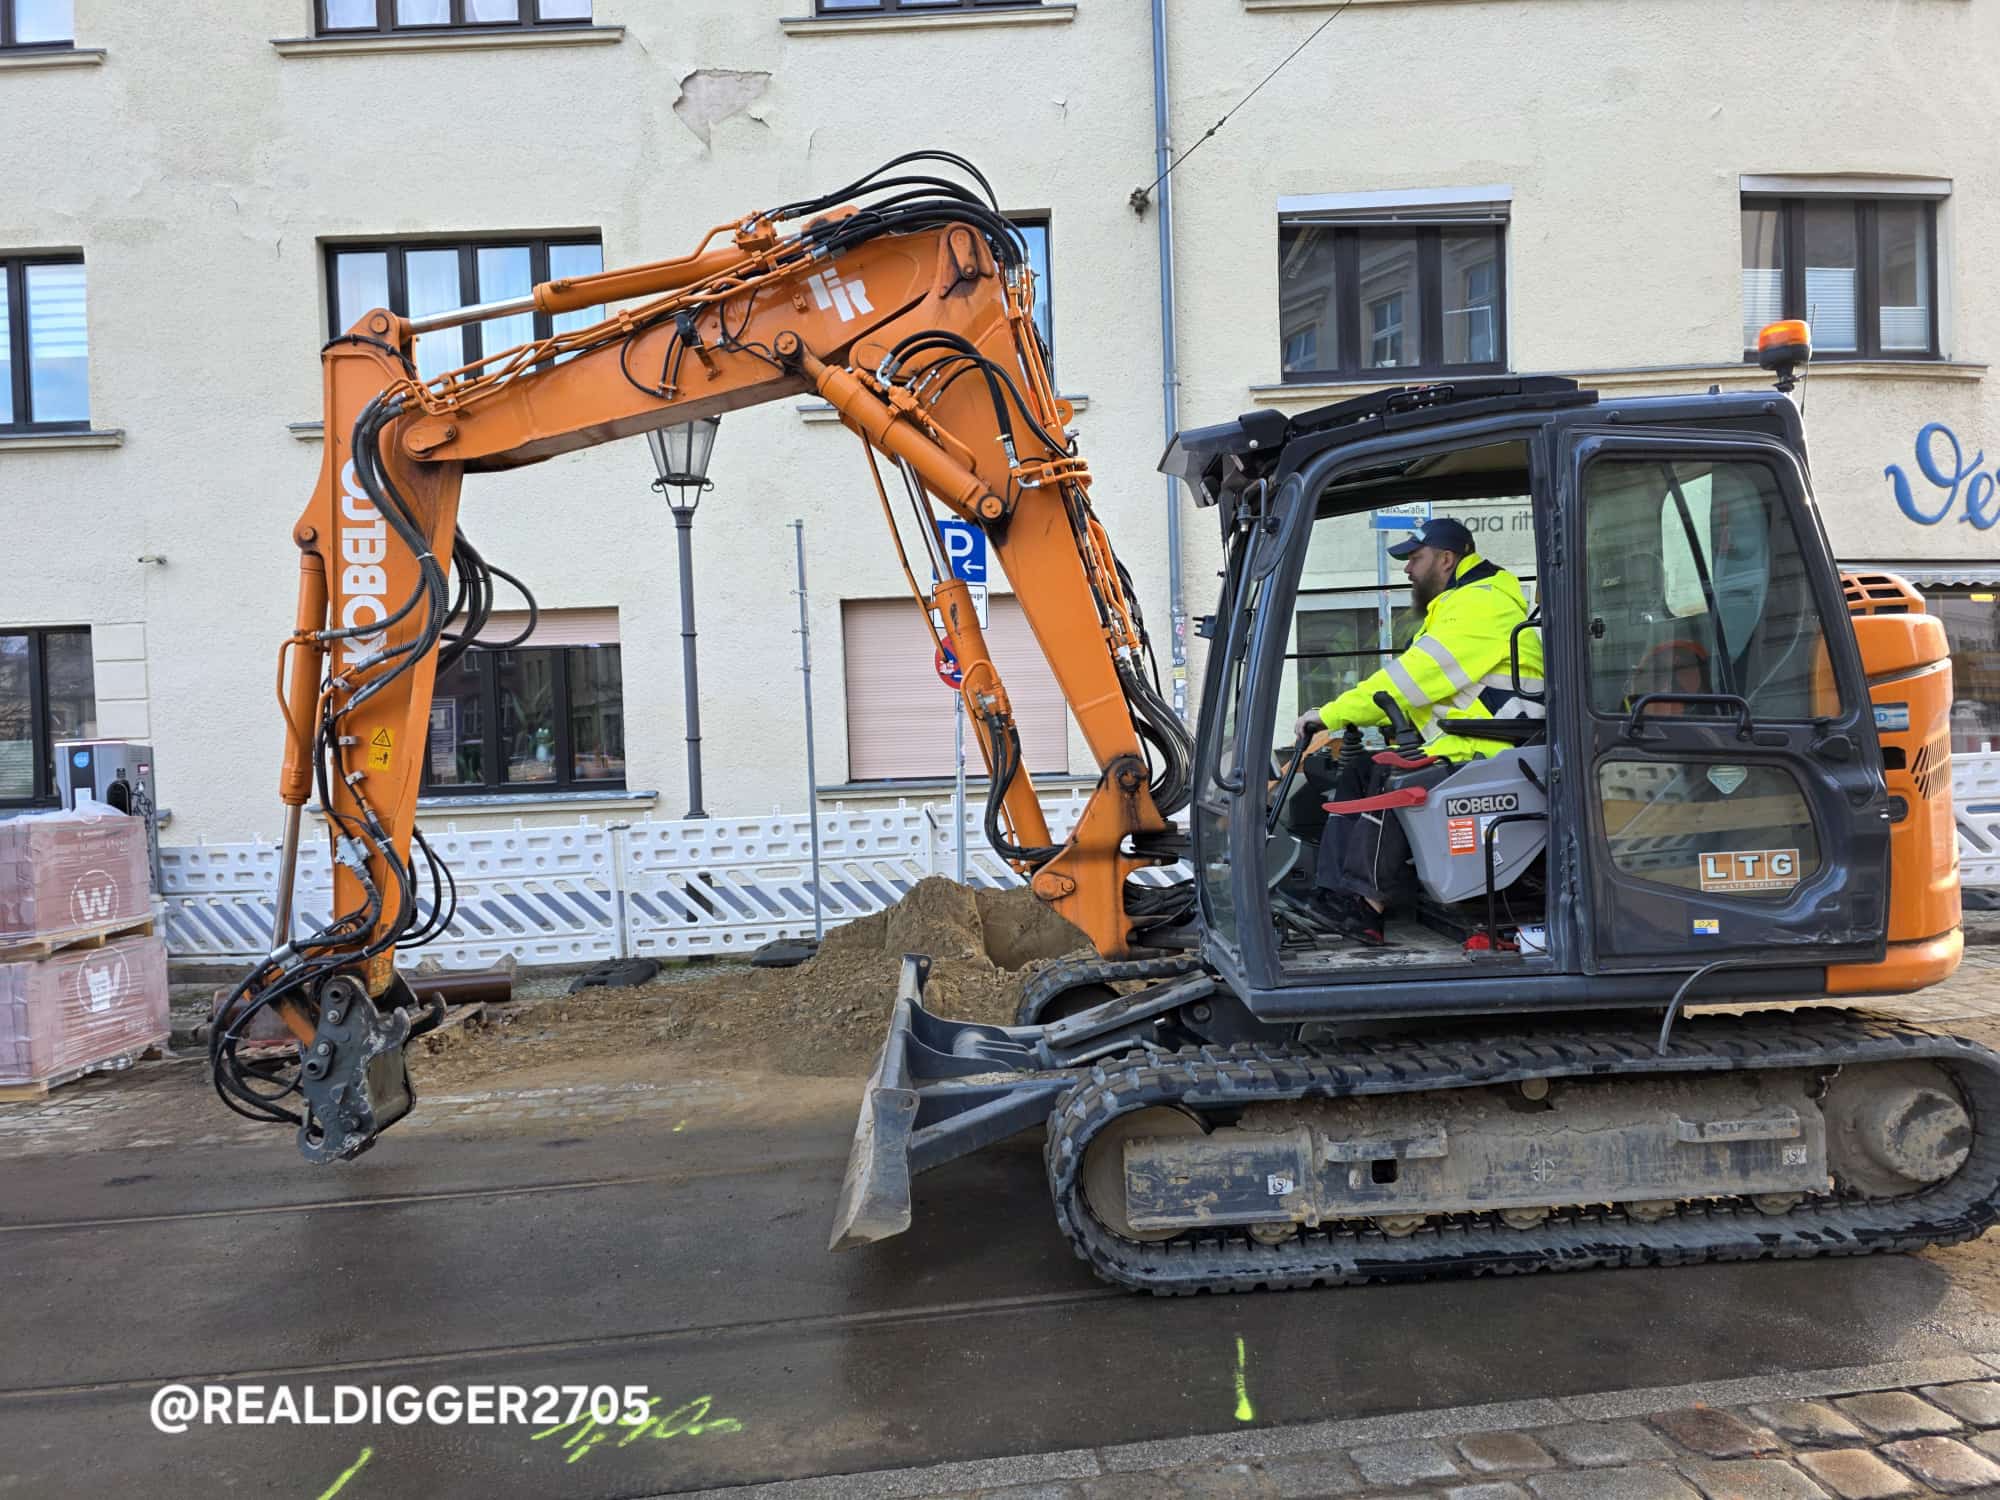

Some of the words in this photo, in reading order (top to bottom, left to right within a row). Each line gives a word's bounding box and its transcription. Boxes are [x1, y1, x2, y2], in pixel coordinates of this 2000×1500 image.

[1883, 422, 2000, 531] Ve
[1511, 511, 1535, 531] rit
[944, 528, 974, 564] P
[1447, 794, 1517, 816] KOBELCO
[1705, 853, 1793, 879] LTG
